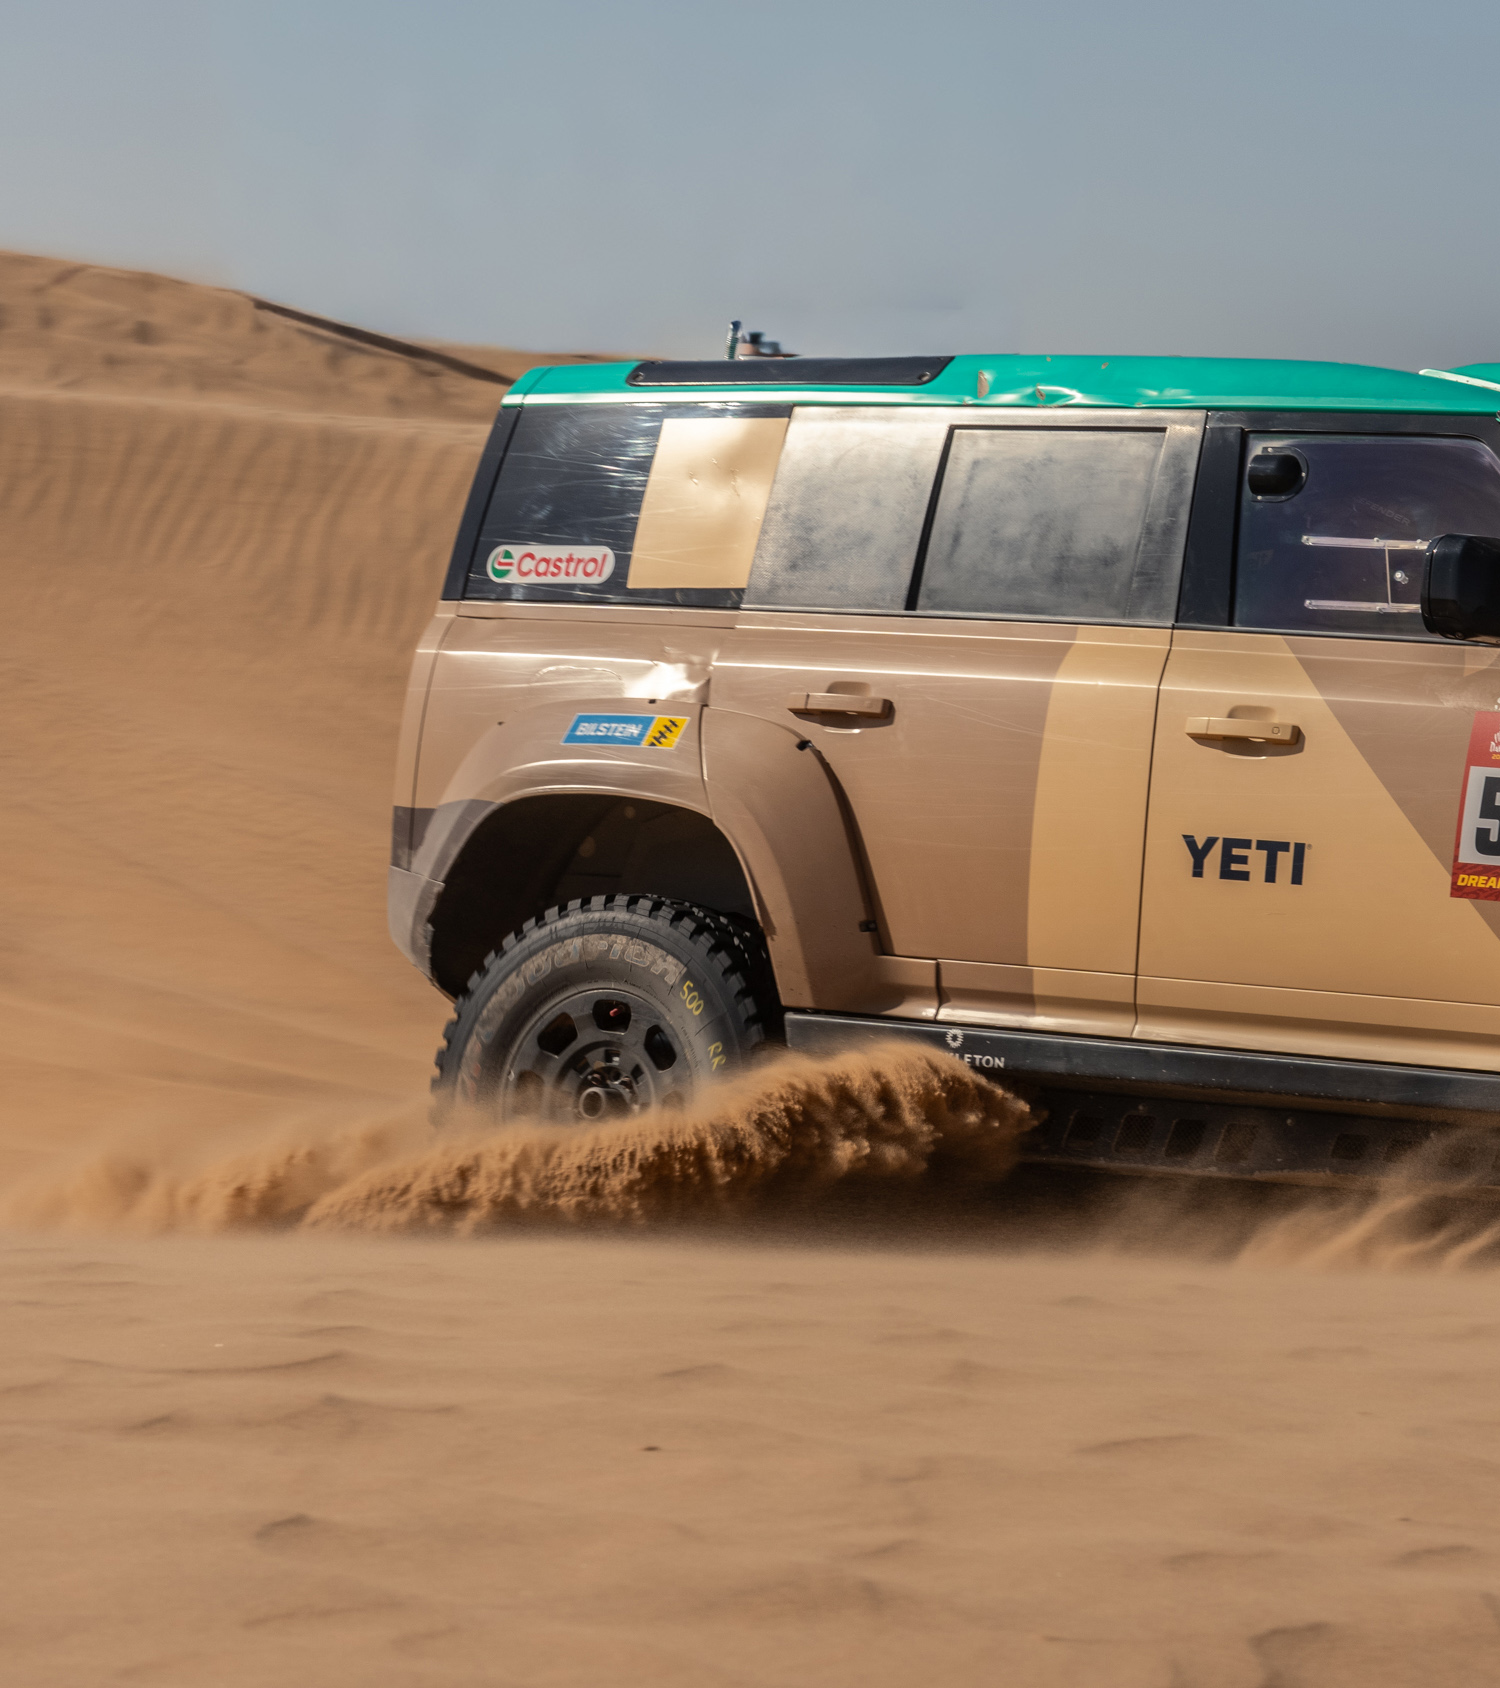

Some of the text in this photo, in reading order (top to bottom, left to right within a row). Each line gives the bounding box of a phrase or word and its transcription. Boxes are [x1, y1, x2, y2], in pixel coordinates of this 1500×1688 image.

[517, 552, 608, 578] Castrol
[575, 722, 643, 737] BILSTEIN
[1181, 834, 1306, 886] YETI
[680, 980, 704, 1015] 500
